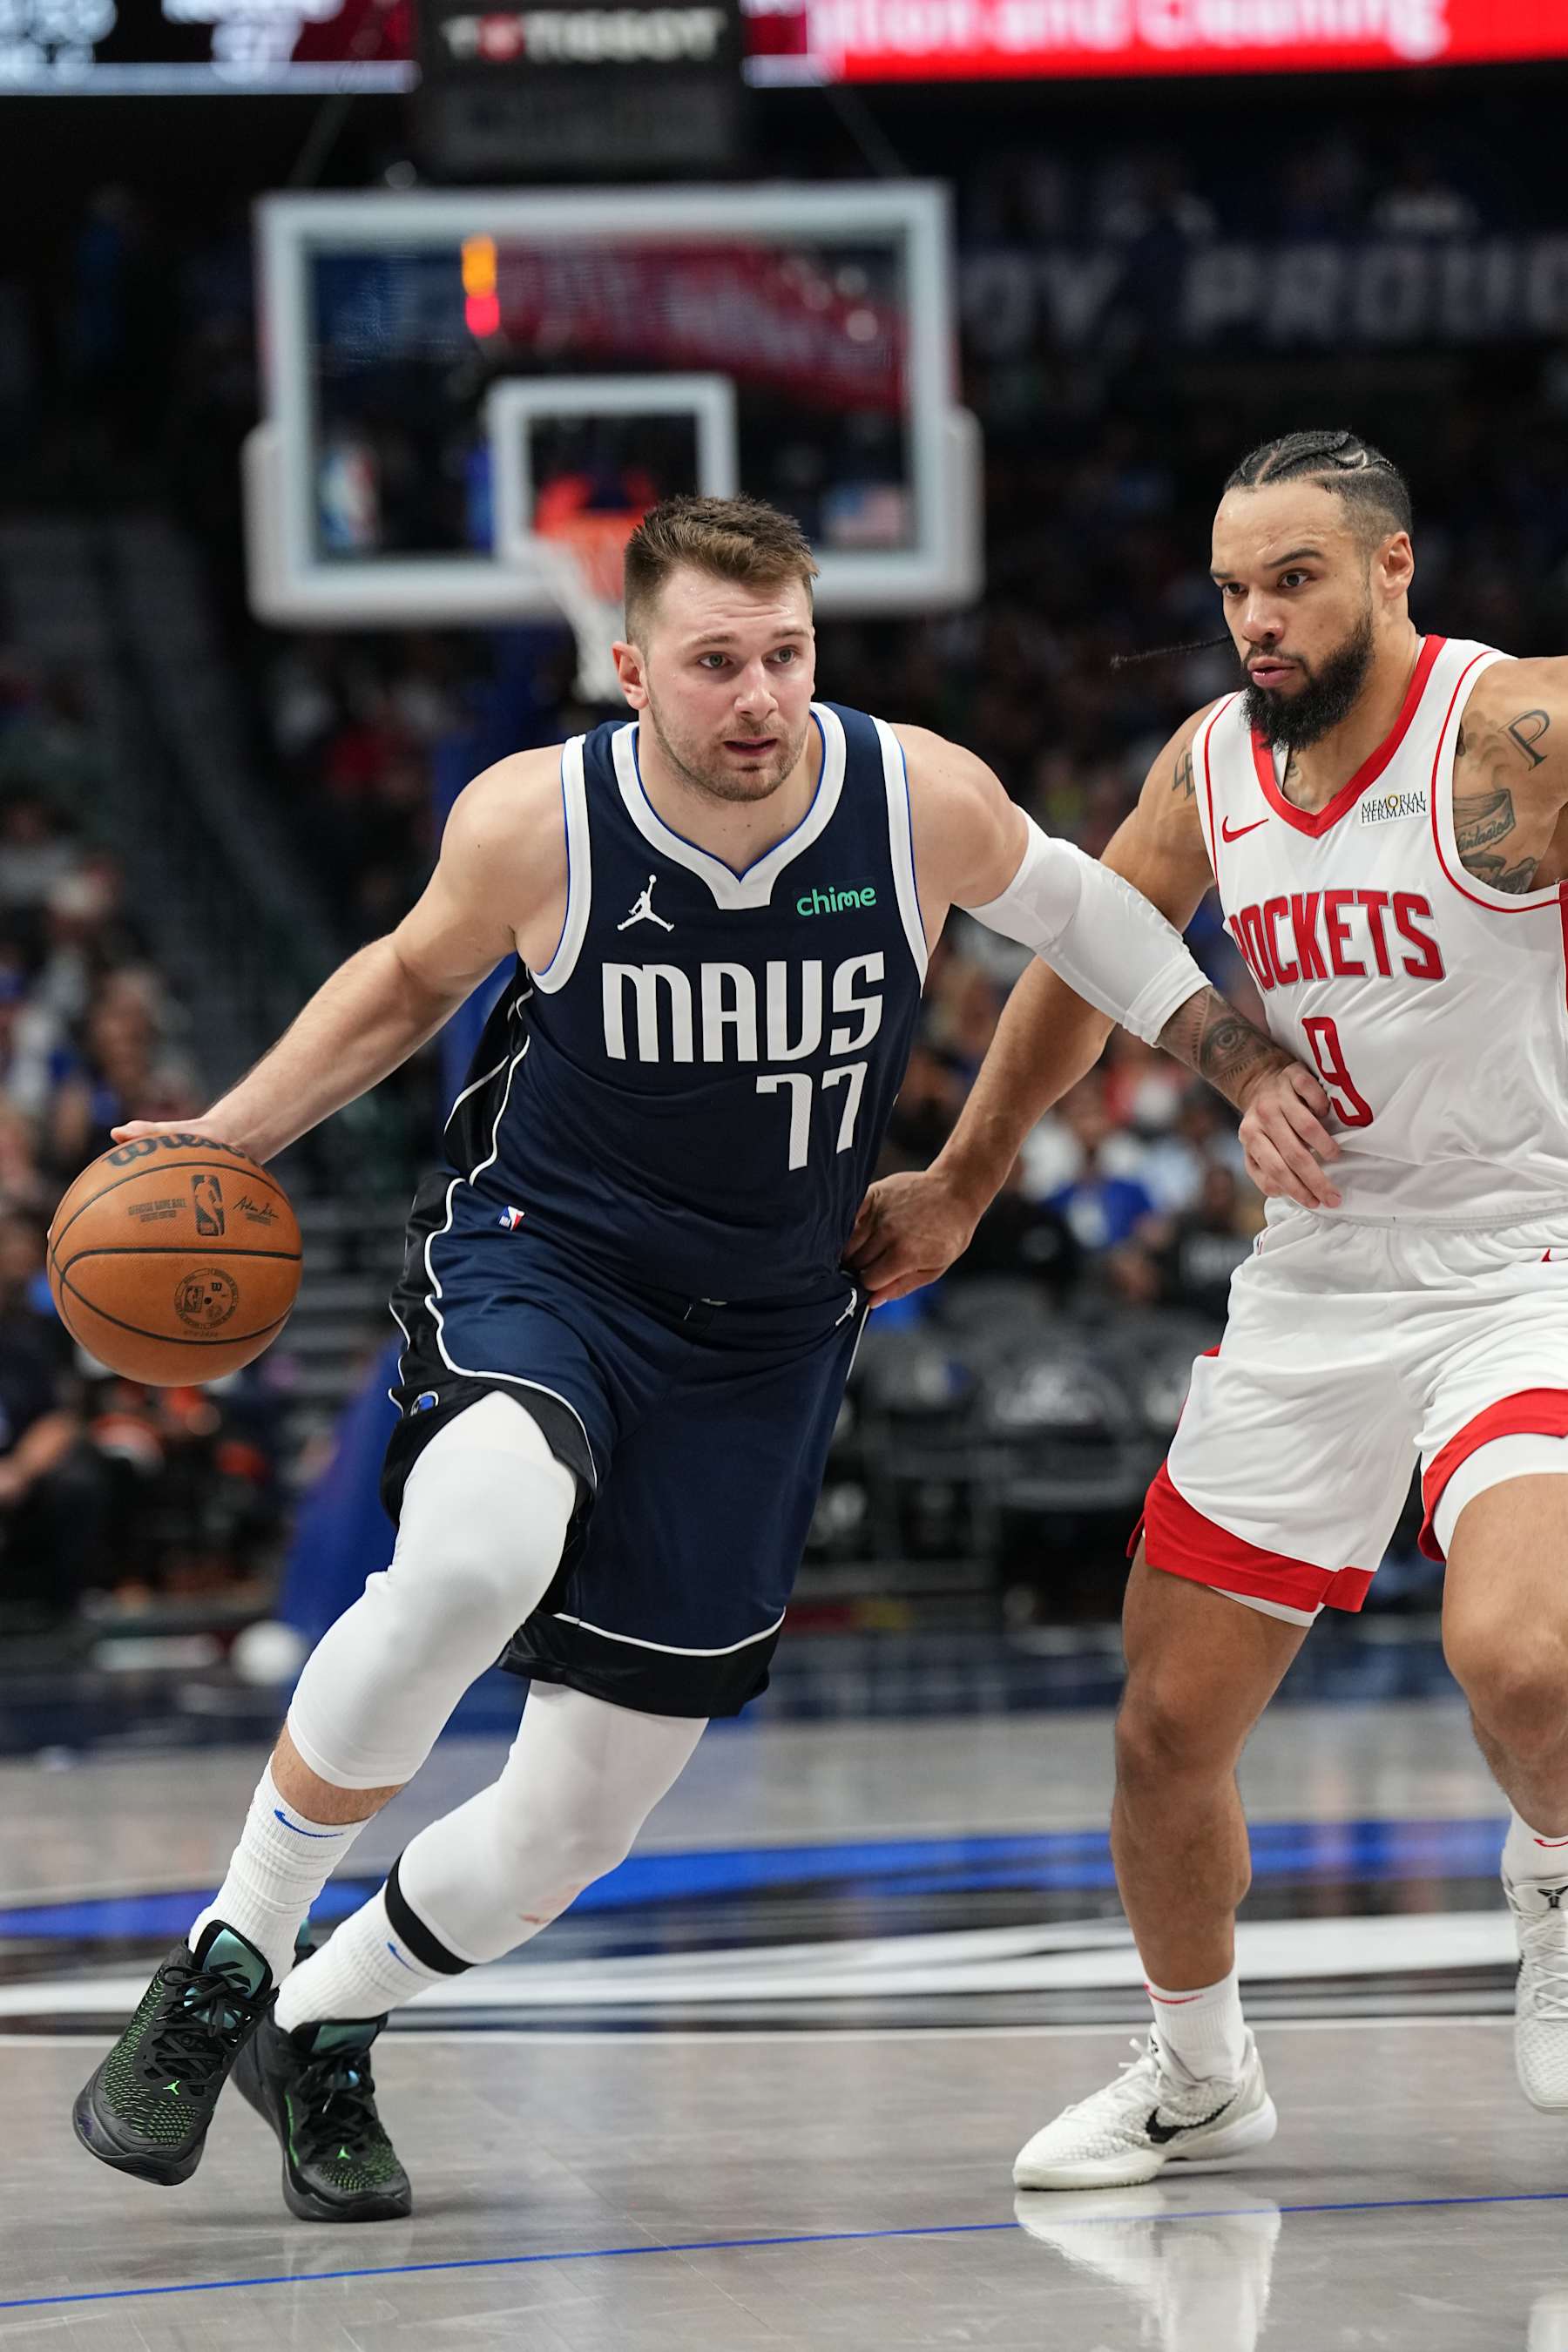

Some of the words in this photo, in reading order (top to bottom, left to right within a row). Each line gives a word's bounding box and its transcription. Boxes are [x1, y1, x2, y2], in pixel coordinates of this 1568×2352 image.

[1497, 709, 1550, 771] P
[1362, 791, 1426, 813] MEMORIAL
[1362, 801, 1427, 823] HERMANN
[796, 886, 877, 916] chime
[602, 951, 884, 1063] MAVS
[1301, 1017, 1374, 1127] 9
[756, 1061, 868, 1171] 77
